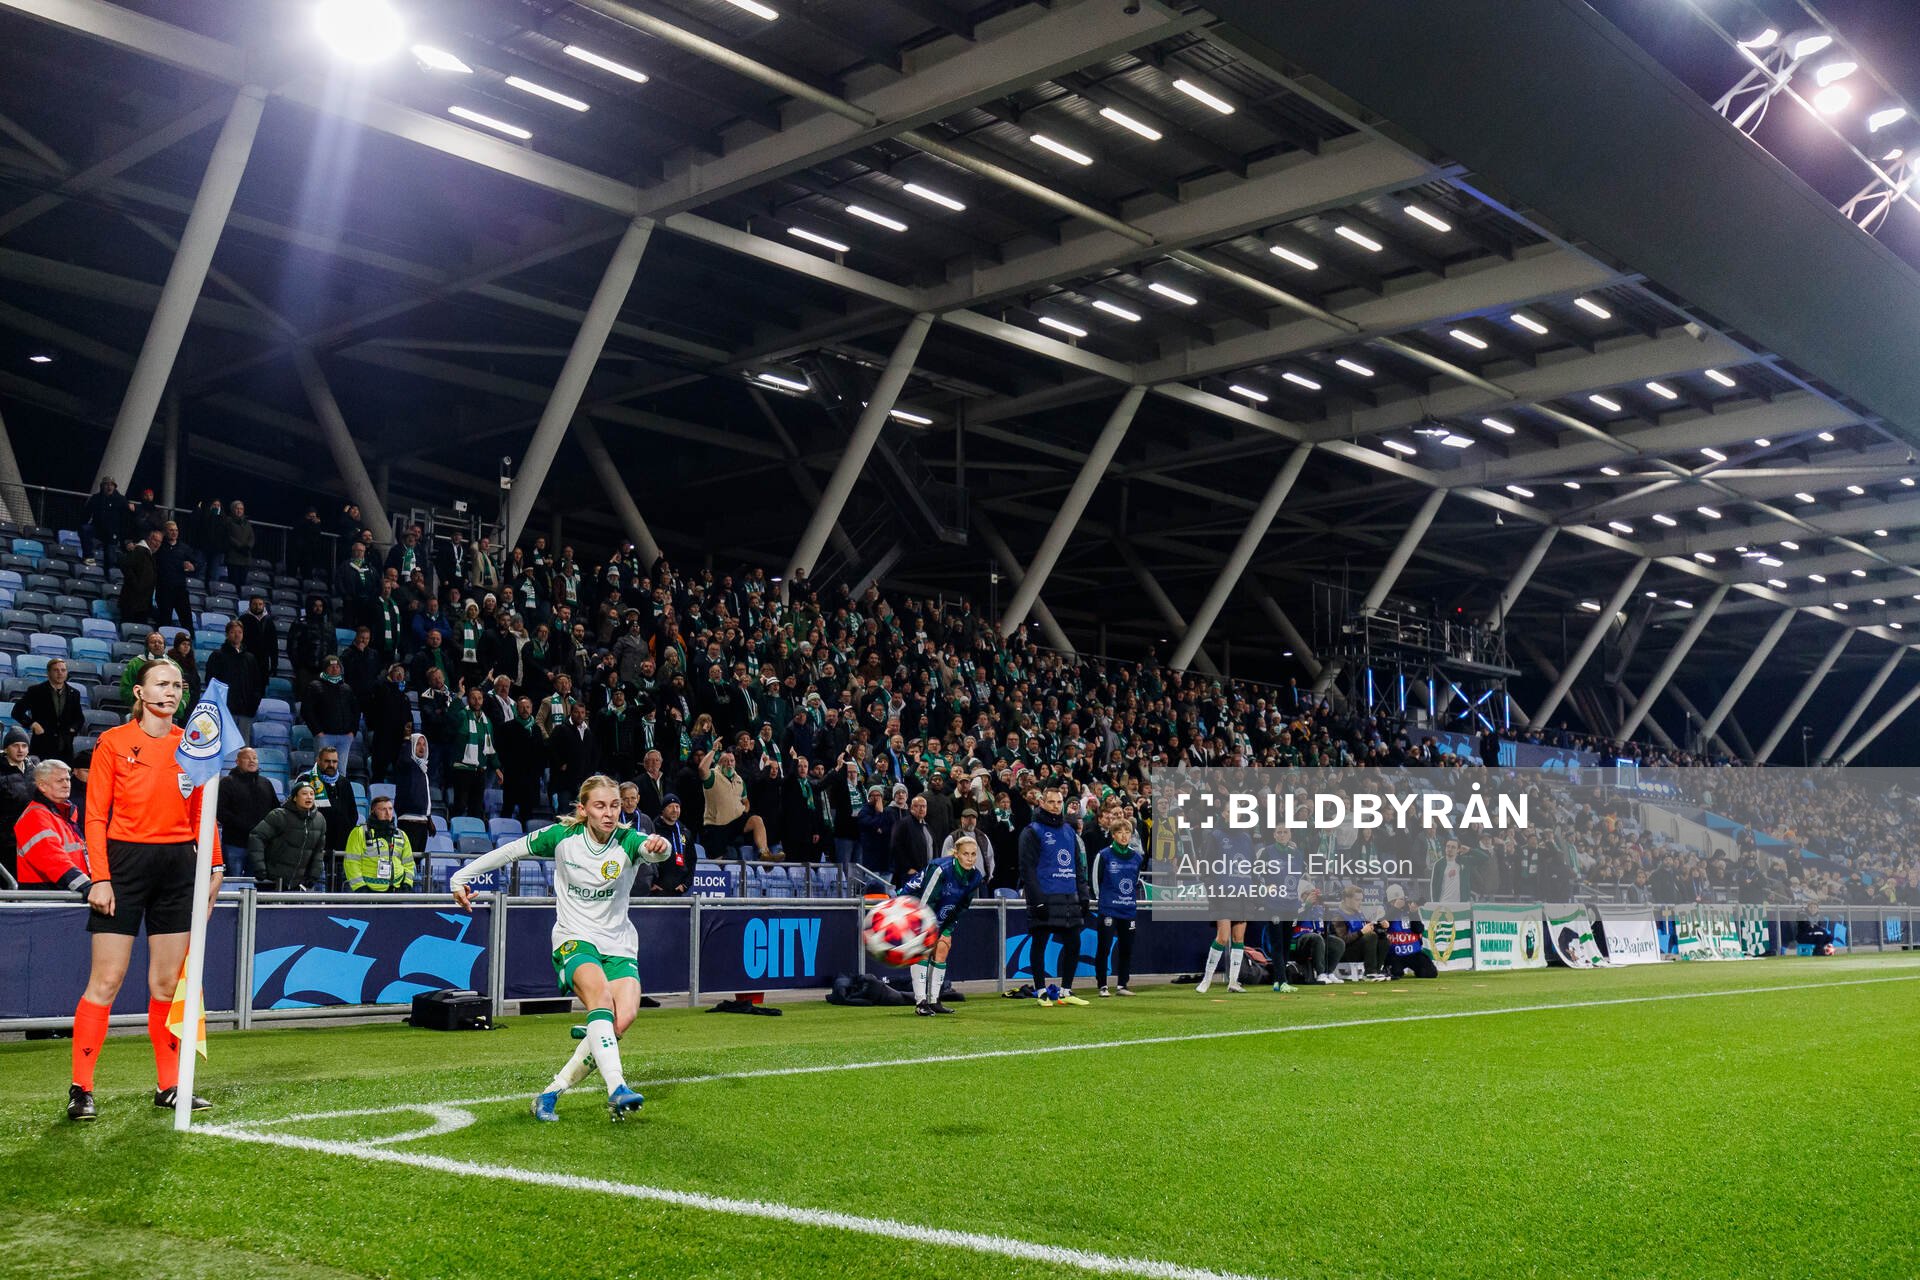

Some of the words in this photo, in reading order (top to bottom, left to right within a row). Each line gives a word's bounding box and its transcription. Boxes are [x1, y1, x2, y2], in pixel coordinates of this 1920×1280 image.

[693, 876, 726, 887] BLOCK
[568, 883, 614, 899] PROJOB
[743, 917, 822, 979] CITY
[1395, 944, 1414, 955] 030
